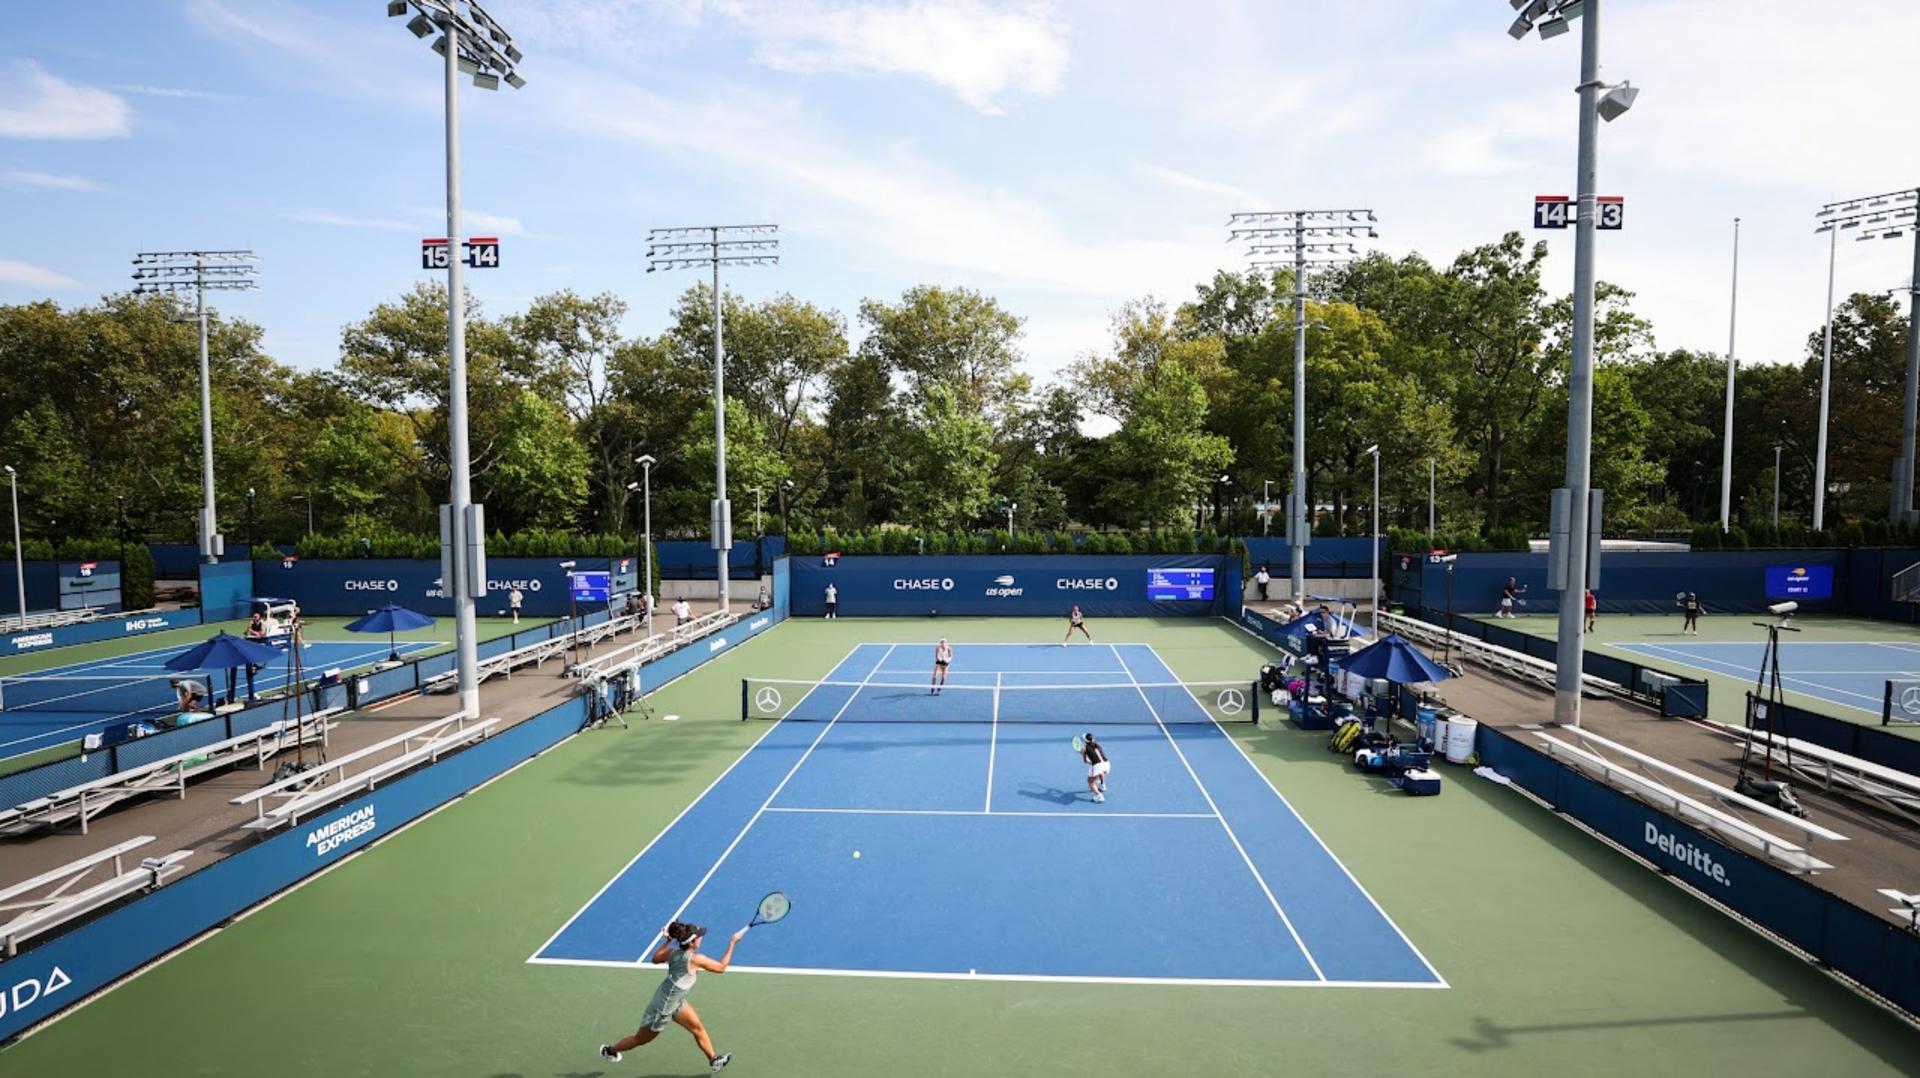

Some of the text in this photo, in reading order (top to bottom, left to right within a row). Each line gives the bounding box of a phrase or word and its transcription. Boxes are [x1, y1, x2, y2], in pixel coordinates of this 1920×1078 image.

[1537, 203, 1567, 226] 14
[1596, 204, 1621, 227] 13
[424, 246, 448, 267] 15
[471, 245, 497, 266] 14
[825, 558, 835, 566] 14
[345, 580, 386, 590] CHASE
[487, 579, 528, 591] CHASE
[893, 578, 940, 590] CHASE
[1056, 578, 1104, 590] CHASE
[998, 587, 1024, 598] open
[125, 619, 146, 631] IHG
[306, 803, 375, 848] AMERICAN
[317, 817, 376, 856] EXPRESS
[1644, 821, 1731, 887] Deloitte.
